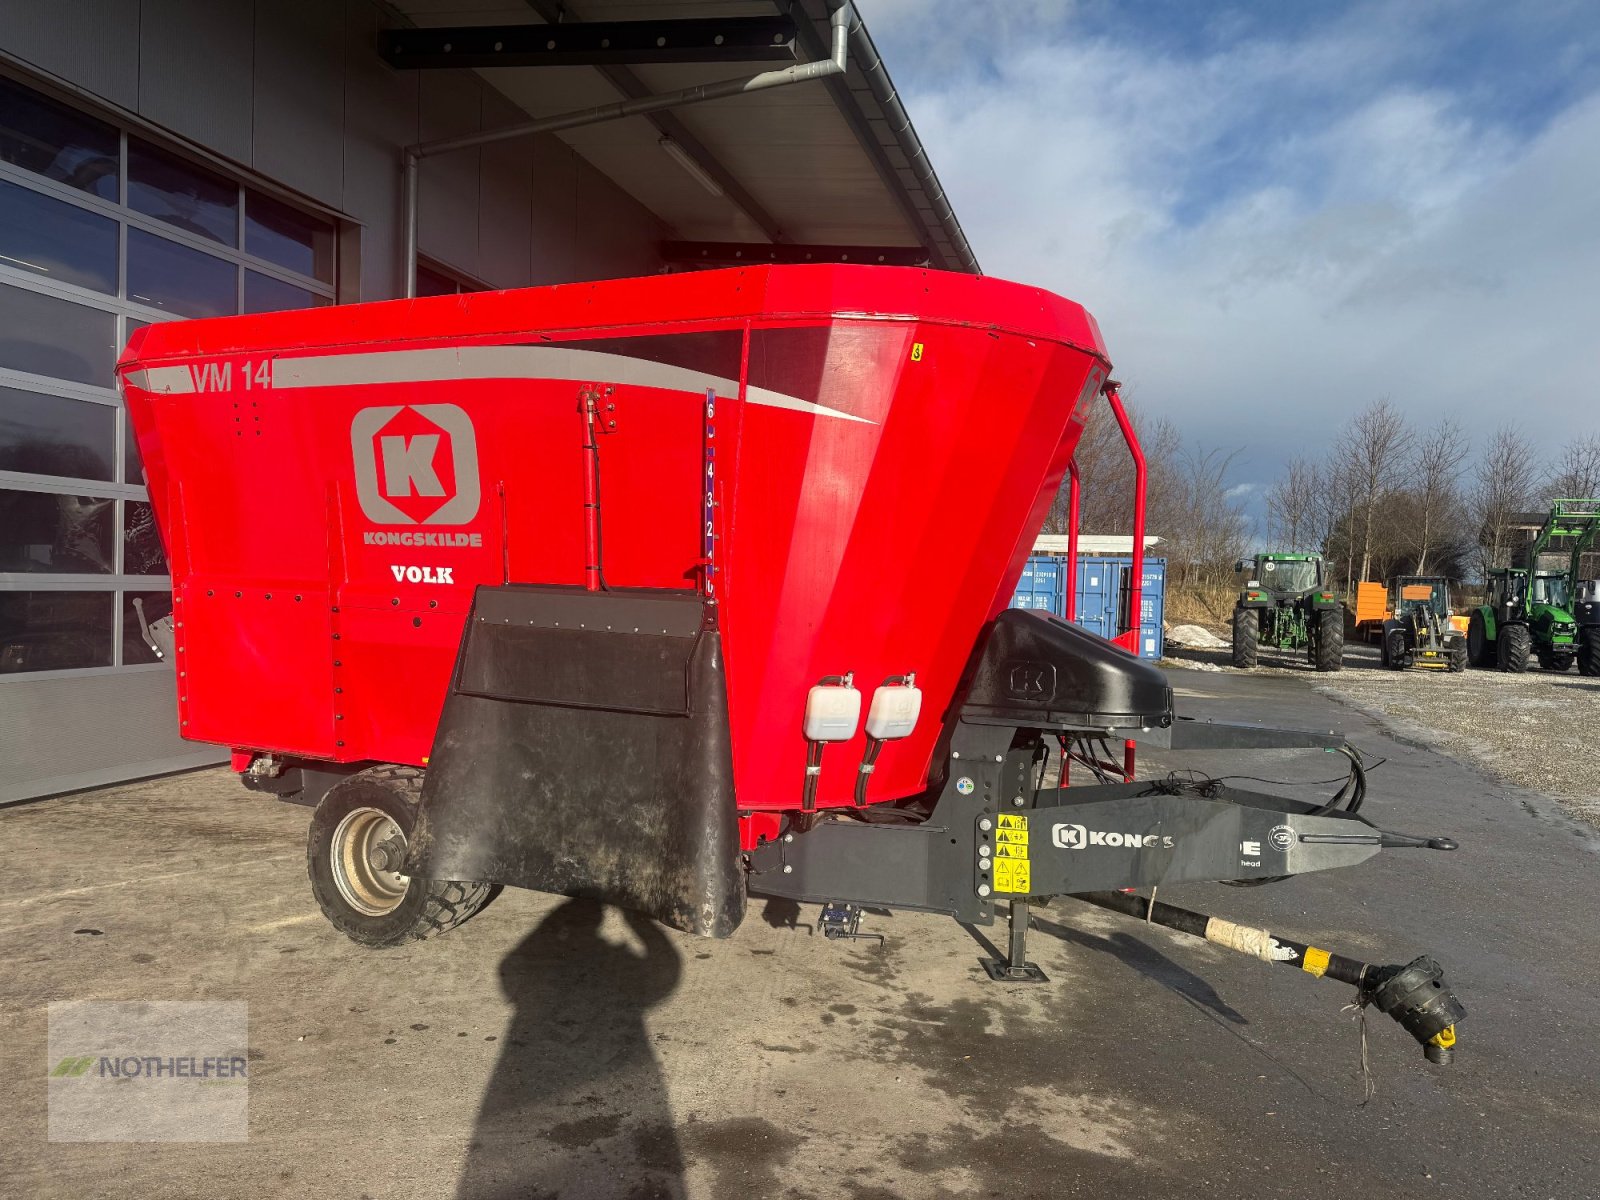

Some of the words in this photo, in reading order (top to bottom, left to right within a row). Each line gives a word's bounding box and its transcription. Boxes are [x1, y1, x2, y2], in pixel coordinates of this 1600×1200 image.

[193, 362, 232, 393] VM
[241, 360, 271, 391] 14
[706, 403, 714, 418] 6
[380, 433, 447, 497] K
[707, 462, 714, 478] 4
[706, 491, 713, 508] 3
[706, 521, 713, 537] 2
[363, 531, 482, 547] KONGSKILDE
[390, 565, 454, 584] VOLK
[1060, 829, 1079, 844] K
